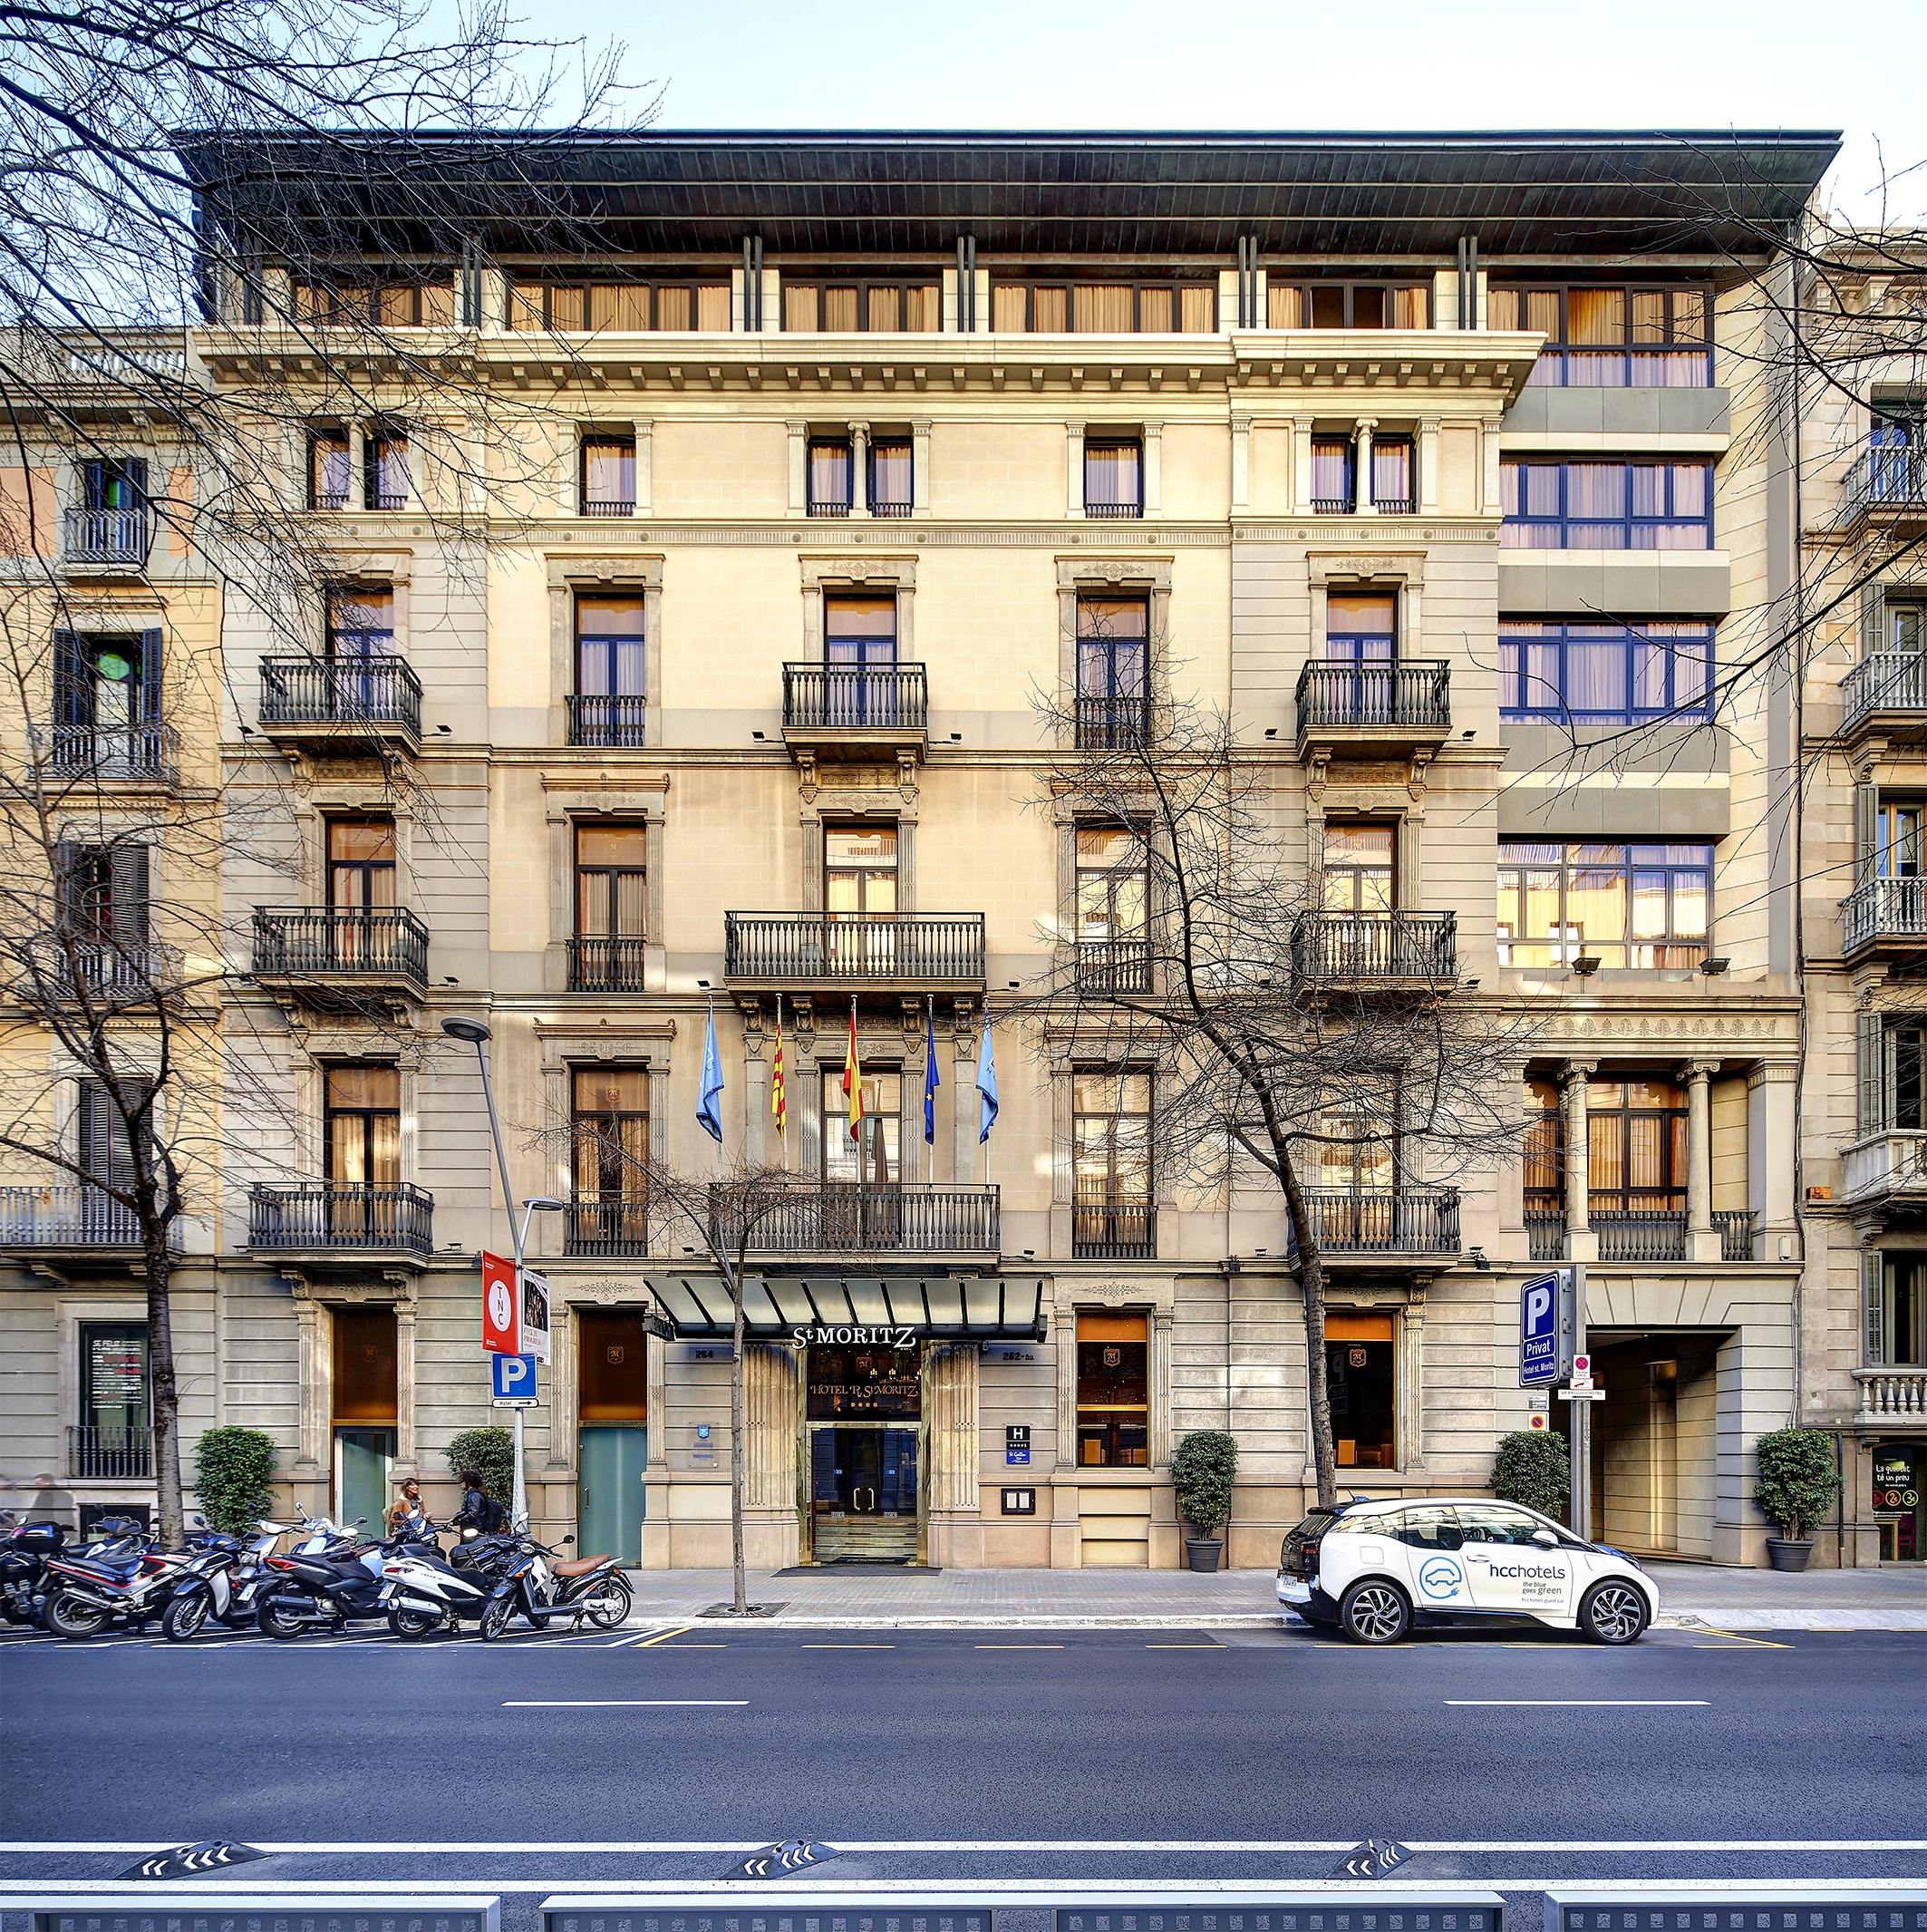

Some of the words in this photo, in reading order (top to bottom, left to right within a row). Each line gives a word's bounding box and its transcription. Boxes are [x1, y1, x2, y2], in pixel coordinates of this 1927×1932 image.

[1527, 1287, 1550, 1335] P
[695, 1349, 713, 1358] 264
[1526, 1339, 1551, 1356] Privat
[501, 1358, 528, 1393] P
[809, 1384, 848, 1394] HOTEL
[1013, 1427, 1023, 1440] H
[1489, 1564, 1565, 1578] hcchotels
[1537, 1587, 1562, 1596] green
